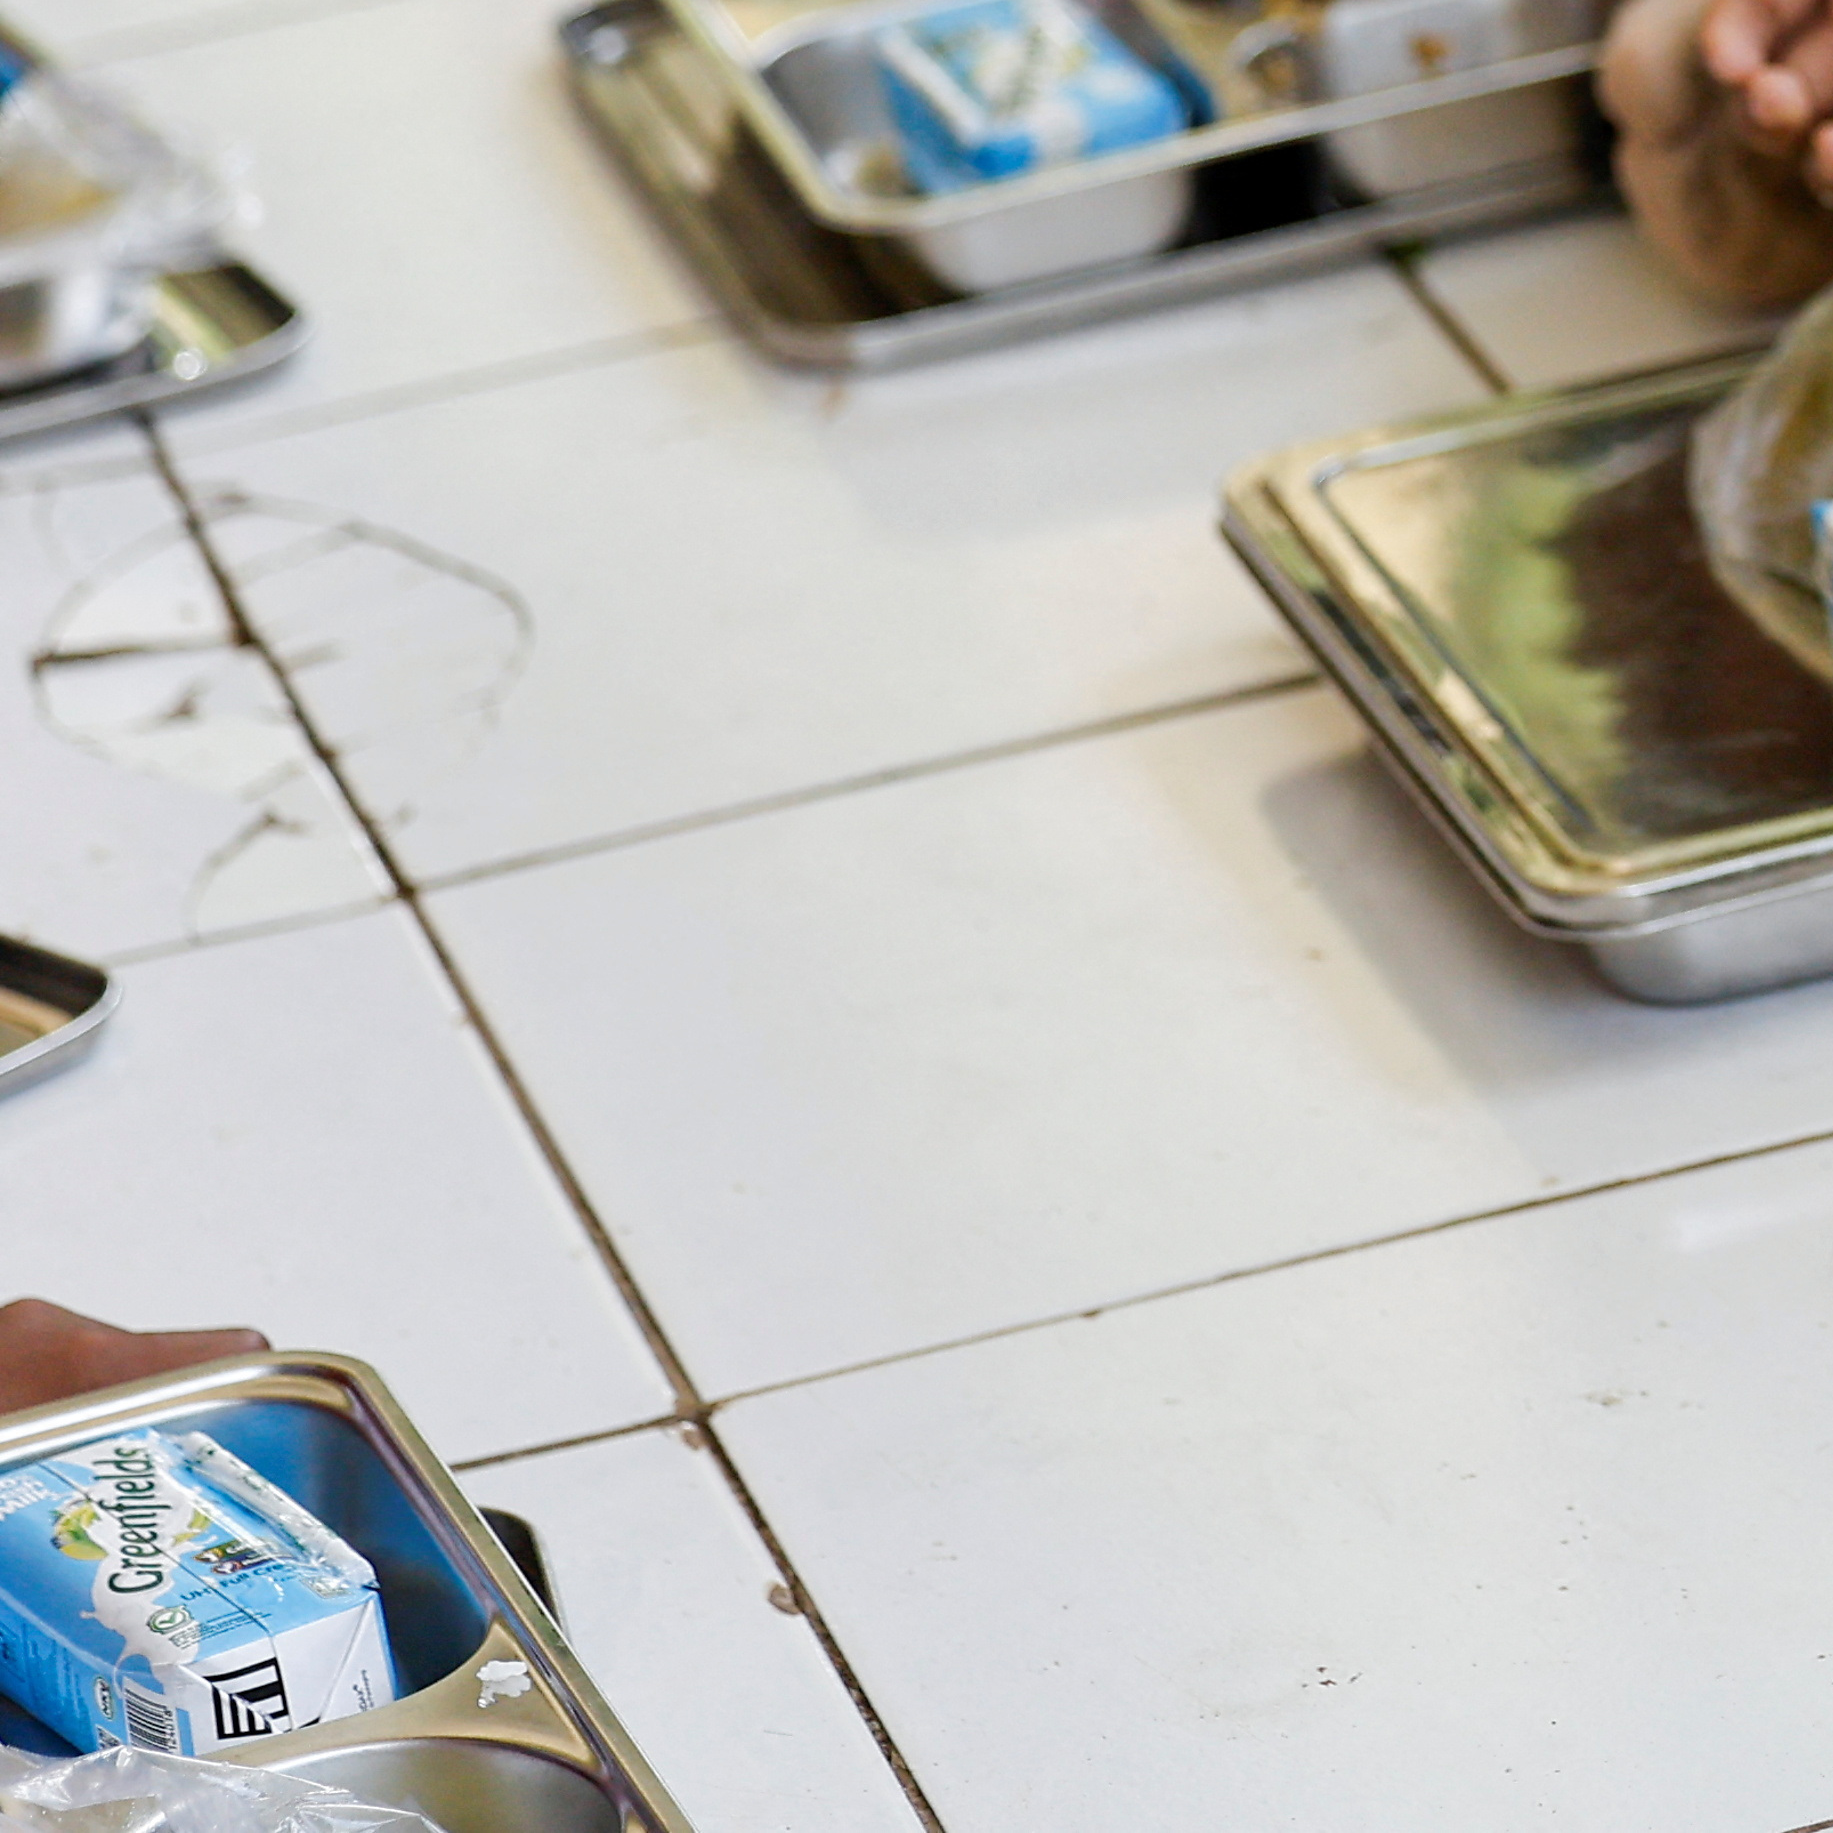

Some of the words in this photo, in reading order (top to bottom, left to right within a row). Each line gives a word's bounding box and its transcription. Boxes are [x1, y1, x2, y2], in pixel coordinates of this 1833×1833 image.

[93, 1447, 172, 1593] Greenfields
[180, 1585, 213, 1602] UH
[220, 1574, 250, 1588] Full
[253, 1563, 288, 1576] Cre
